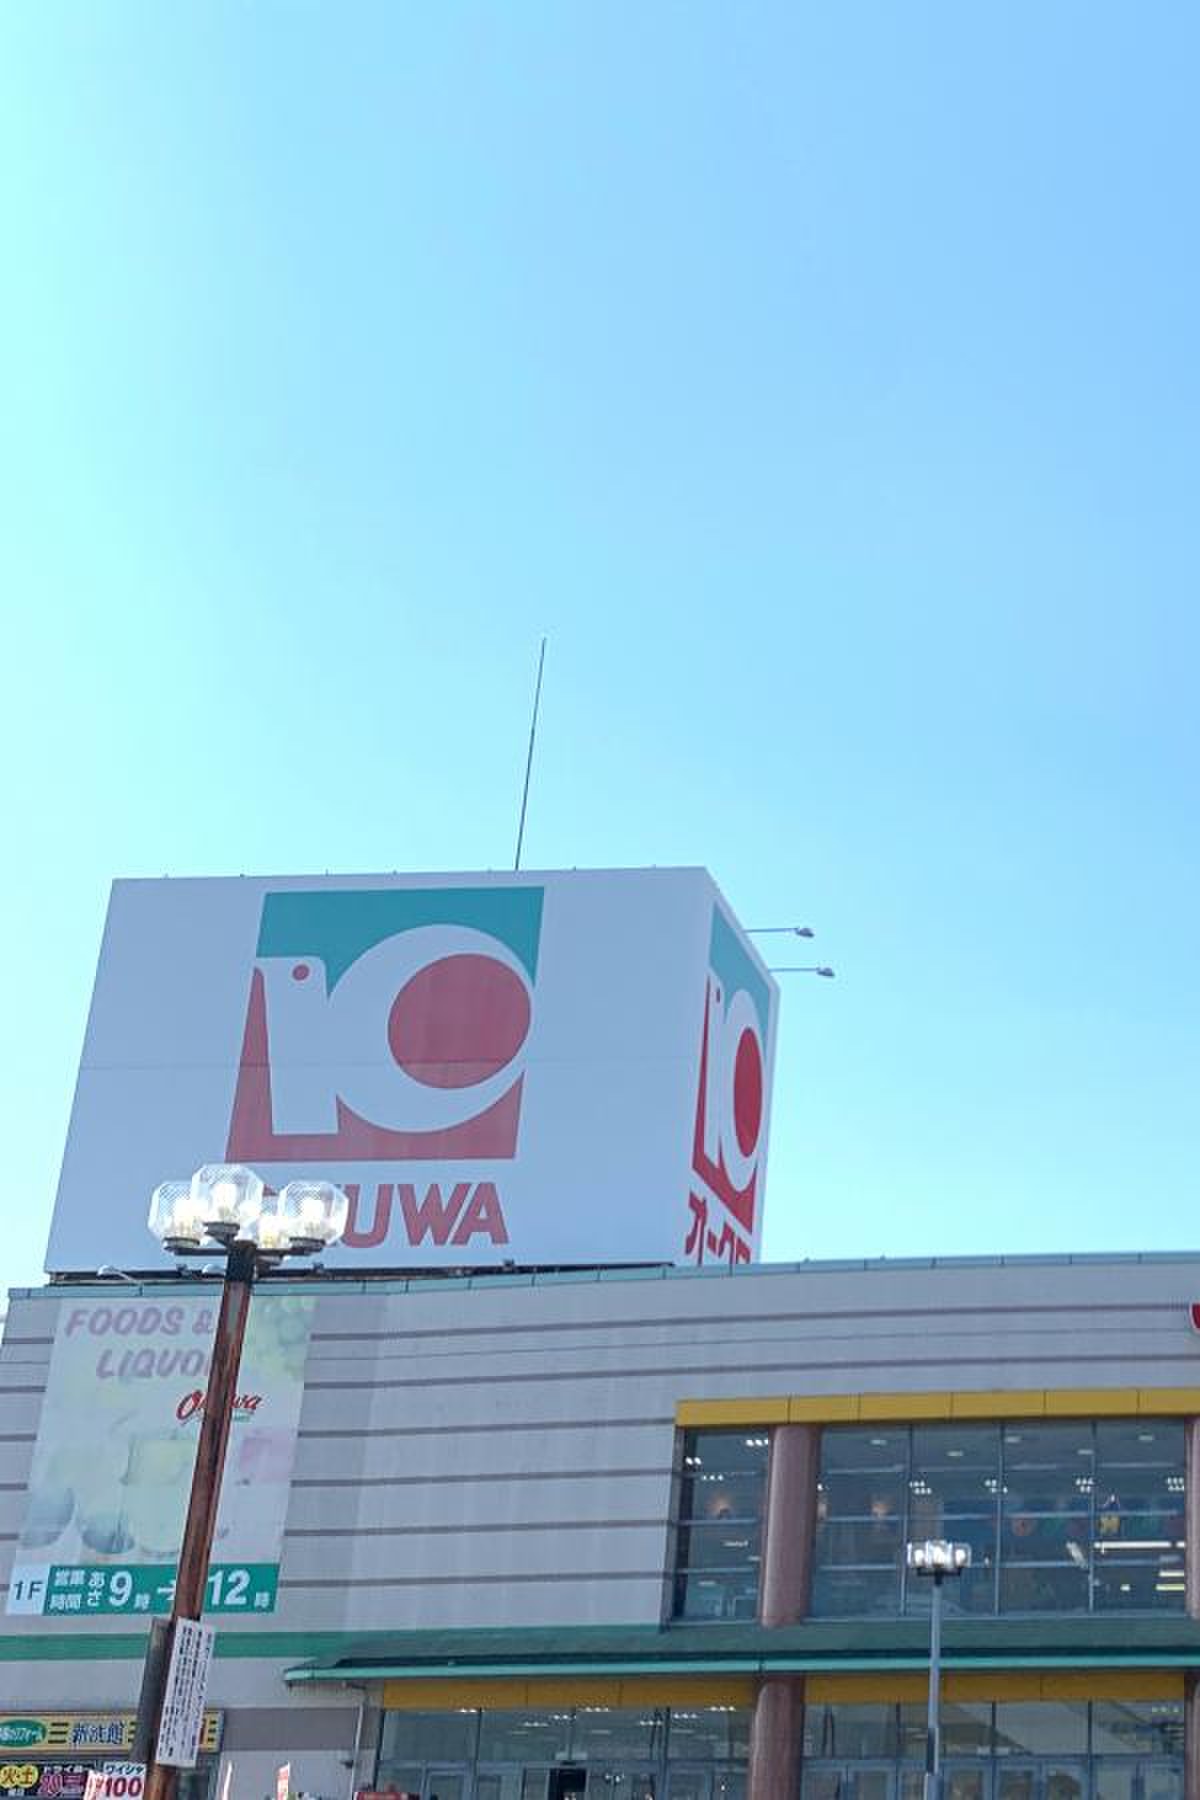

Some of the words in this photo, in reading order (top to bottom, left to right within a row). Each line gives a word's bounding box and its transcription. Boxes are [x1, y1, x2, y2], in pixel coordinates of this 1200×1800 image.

[262, 1182, 509, 1249] UWA
[65, 1306, 185, 1338] FOODS
[97, 1347, 210, 1379] LIQUO
[13, 1580, 43, 1601] 1F
